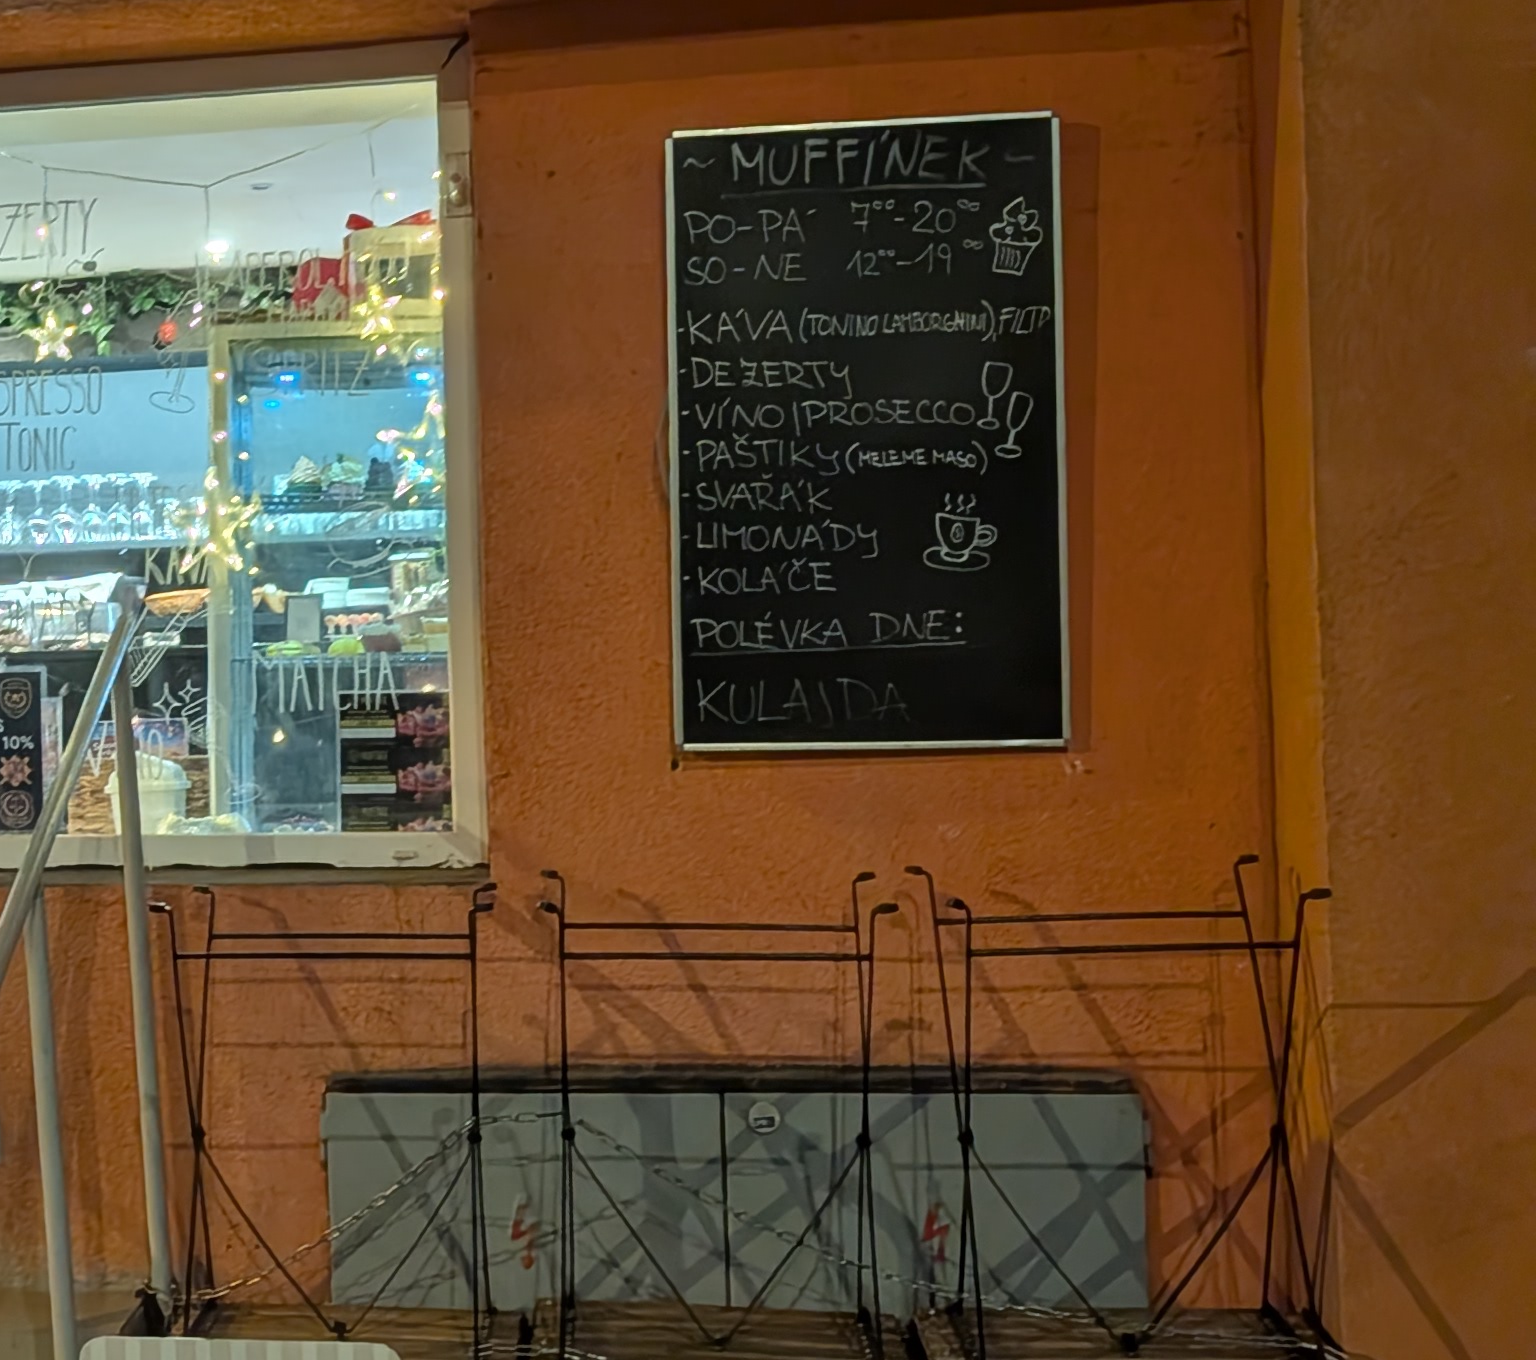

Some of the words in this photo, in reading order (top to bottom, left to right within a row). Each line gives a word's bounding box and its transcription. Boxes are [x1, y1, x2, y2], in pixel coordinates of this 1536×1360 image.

[731, 130, 990, 186] MUFFÍNEK
[686, 308, 794, 345] KÁVA
[690, 357, 852, 400] DEZERTY
[697, 433, 841, 476] PAŠTIKY
[696, 474, 832, 512] SVAŘÁK
[697, 519, 878, 559] LIMONÁDY
[697, 558, 837, 596] KOLÁČE
[690, 611, 848, 650] POLÉVKA
[252, 651, 400, 714] MATCHA
[697, 678, 911, 728] KULAJDA
[2, 735, 35, 750] 10%
